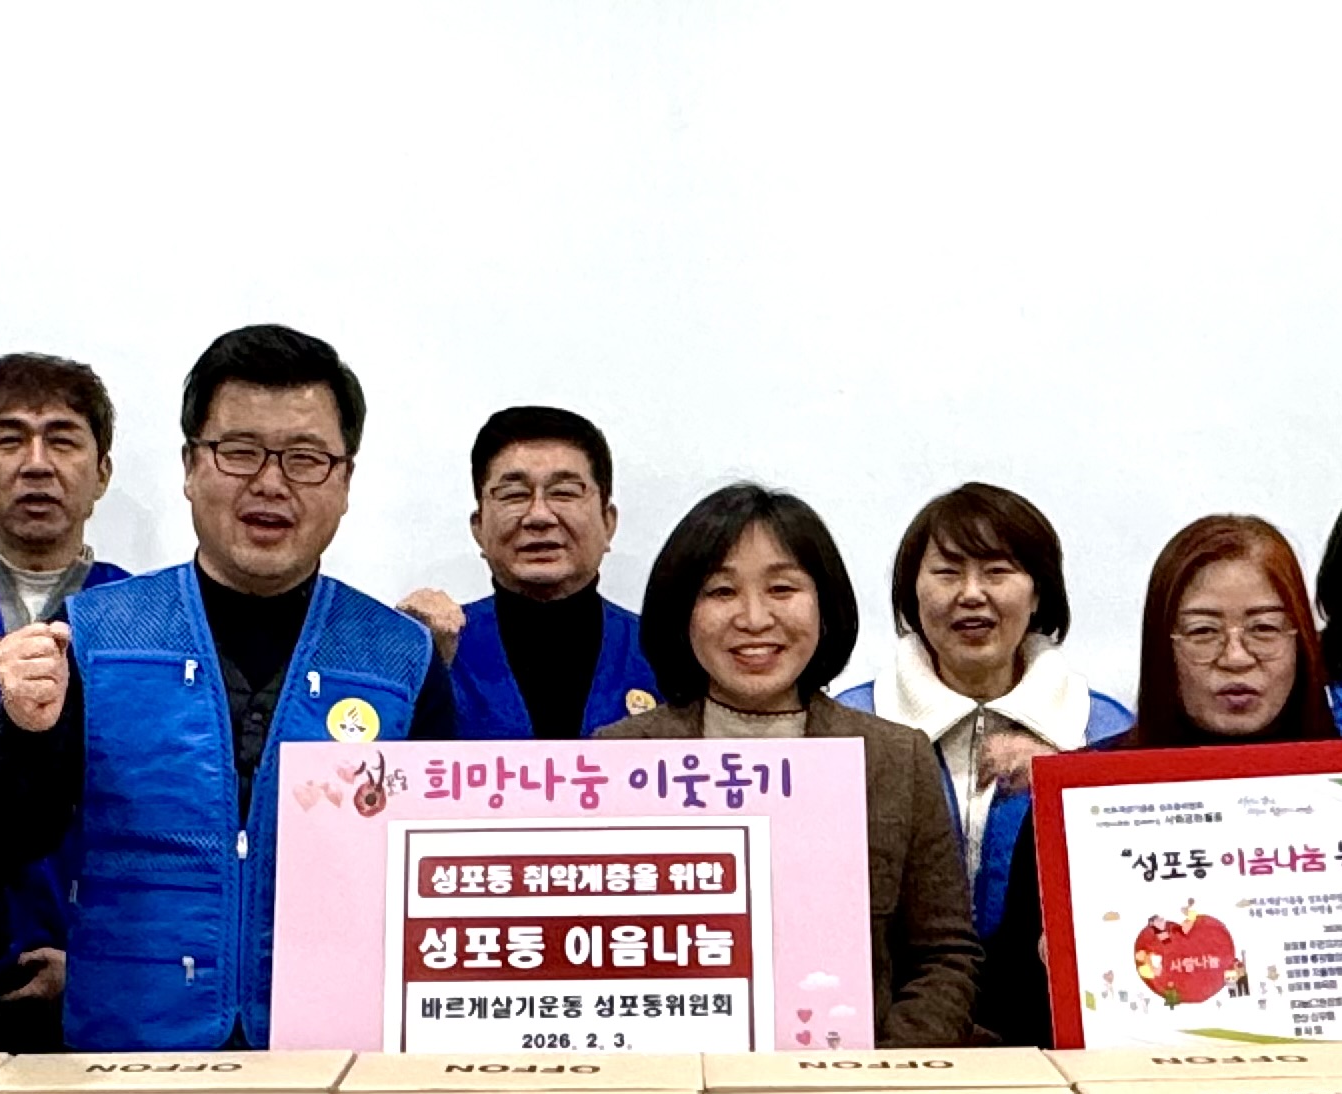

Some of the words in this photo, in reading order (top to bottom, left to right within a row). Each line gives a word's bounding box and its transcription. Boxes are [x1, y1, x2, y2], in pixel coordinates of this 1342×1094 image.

[424, 754, 609, 809] 희망나눔
[628, 753, 793, 809] 이웃돕기
[1221, 844, 1326, 876] 이음나눔
[431, 864, 513, 894] 성포동
[522, 863, 659, 893] 취약계층을
[668, 862, 725, 891] 위한
[419, 926, 546, 969] 성포동
[564, 923, 735, 968] 이음나눔
[420, 995, 583, 1020] 바르게살기운동
[593, 993, 733, 1018] 성포동위원회
[521, 1033, 577, 1050] 2026.
[86, 1064, 244, 1074] OFFON
[445, 1065, 602, 1075] OFFON
[800, 1061, 955, 1070] OFFON
[1152, 1056, 1310, 1066] OFFON
